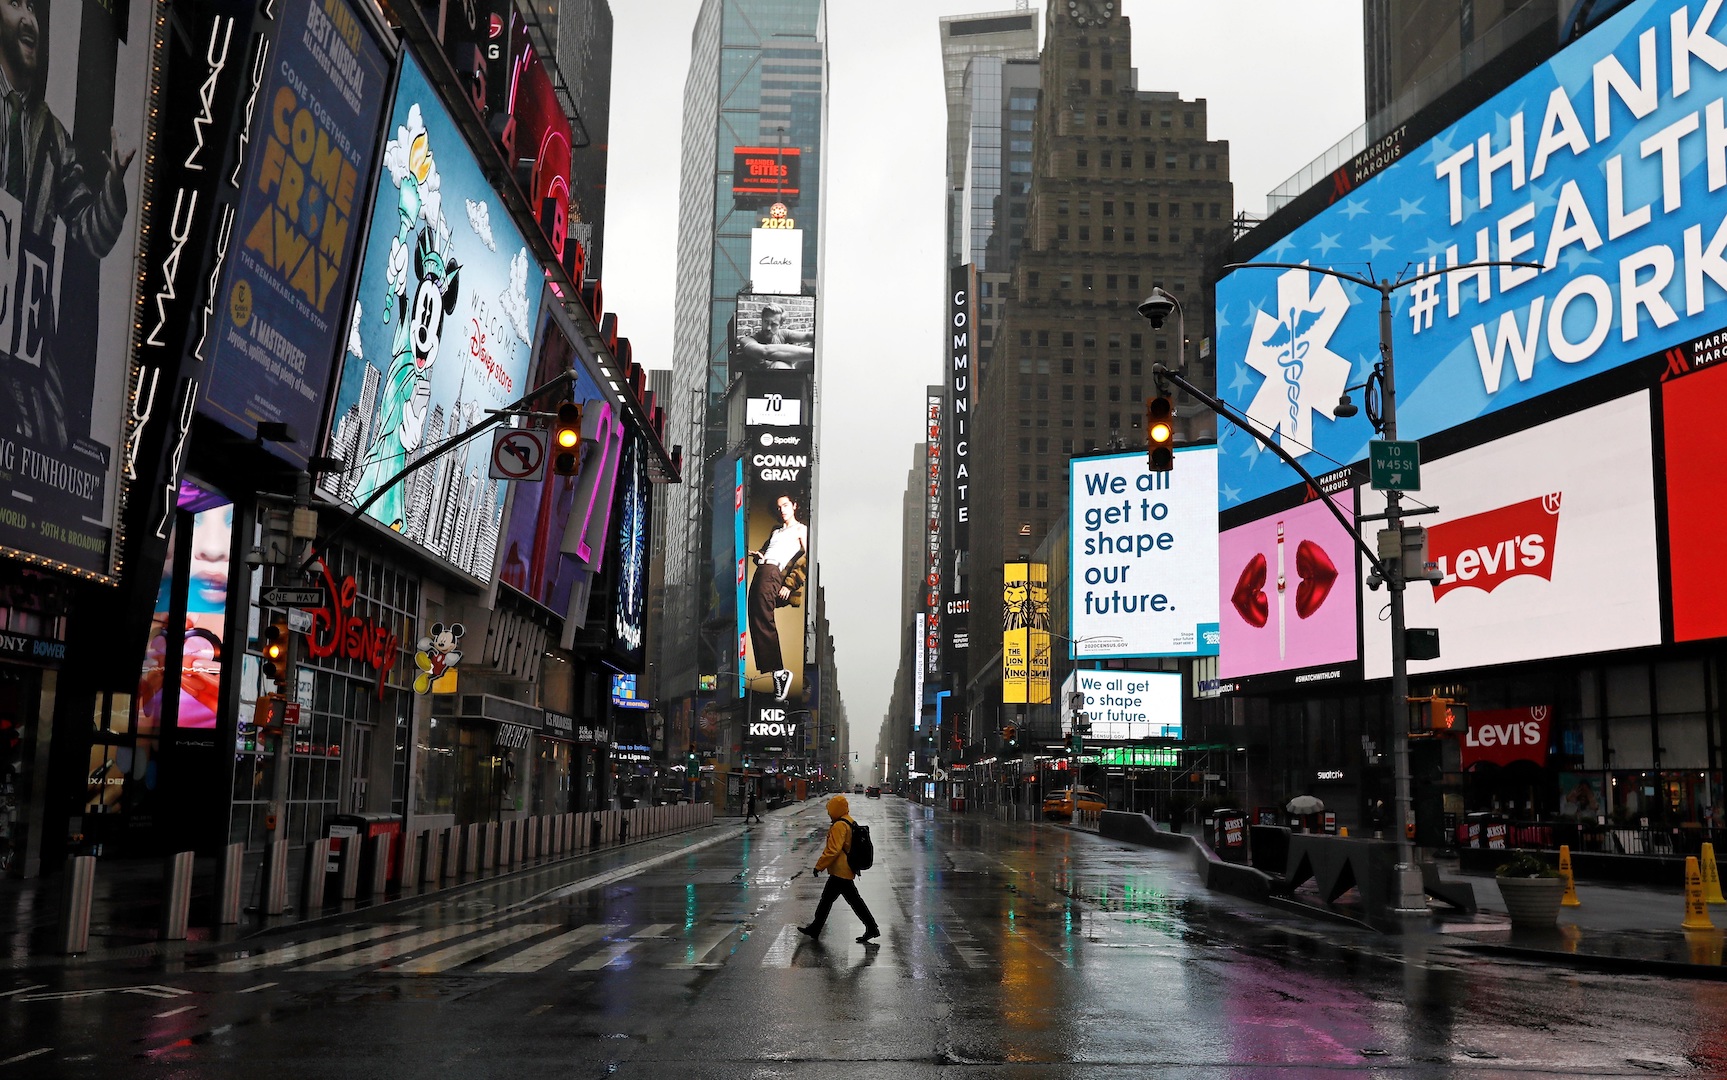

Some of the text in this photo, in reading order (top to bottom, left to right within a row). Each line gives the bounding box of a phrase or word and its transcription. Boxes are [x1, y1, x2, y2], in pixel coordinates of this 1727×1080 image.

[306, 0, 365, 100] BEST MUSICAL
[281, 60, 362, 168] COME TOGETHER AT
[1436, 0, 1727, 226] THANK
[273, 86, 359, 222] COME
[1354, 124, 1407, 170] MARRIOTT
[750, 165, 788, 176] CITIES
[1354, 143, 1402, 183] MARQUIS
[761, 218, 794, 229] 2020
[243, 204, 340, 315] AWAY
[759, 255, 792, 266] Clarks
[240, 252, 328, 333] THE REMARKABLE TRUE STORY
[1471, 212, 1727, 394] WORK
[471, 289, 517, 361] WELCOME
[256, 320, 307, 376] MASTERPIECE!
[470, 318, 495, 382] Disney
[494, 364, 513, 393] store
[270, 356, 282, 376] and
[279, 364, 296, 389] plenty
[457, 349, 466, 363] AT
[467, 360, 486, 386] TIMES
[764, 394, 782, 412] 70
[954, 290, 968, 523] COMMUNICATE
[774, 436, 800, 446] Spotify
[1388, 446, 1401, 456] TO
[752, 454, 806, 468] CONAN
[1377, 460, 1412, 470] W 45 St
[760, 468, 800, 481] GRAY
[1084, 471, 1170, 496] We all
[1320, 467, 1352, 486] MARRIOTT
[1084, 498, 1168, 532] get to
[40, 521, 59, 540] 50TH
[60, 530, 66, 543] &
[68, 530, 107, 554] BROADWAY
[1084, 531, 1174, 558] shape
[1084, 565, 1130, 585] our
[269, 593, 315, 602] ONE WAY
[1084, 590, 1176, 615] future.
[1006, 656, 1023, 666] LION
[1004, 667, 1028, 680] KING
[1295, 670, 1341, 684] #SWATCHWITHLOVE
[1081, 678, 1150, 694] We all get
[1100, 694, 1142, 709] shape
[760, 708, 786, 722] KID
[1107, 709, 1150, 722] future.
[750, 723, 796, 736] KROW
[1318, 770, 1340, 780] swatch
[1224, 818, 1243, 830] JERSEY
[1486, 824, 1506, 838] JERSEY
[1226, 832, 1242, 844] BOYS
